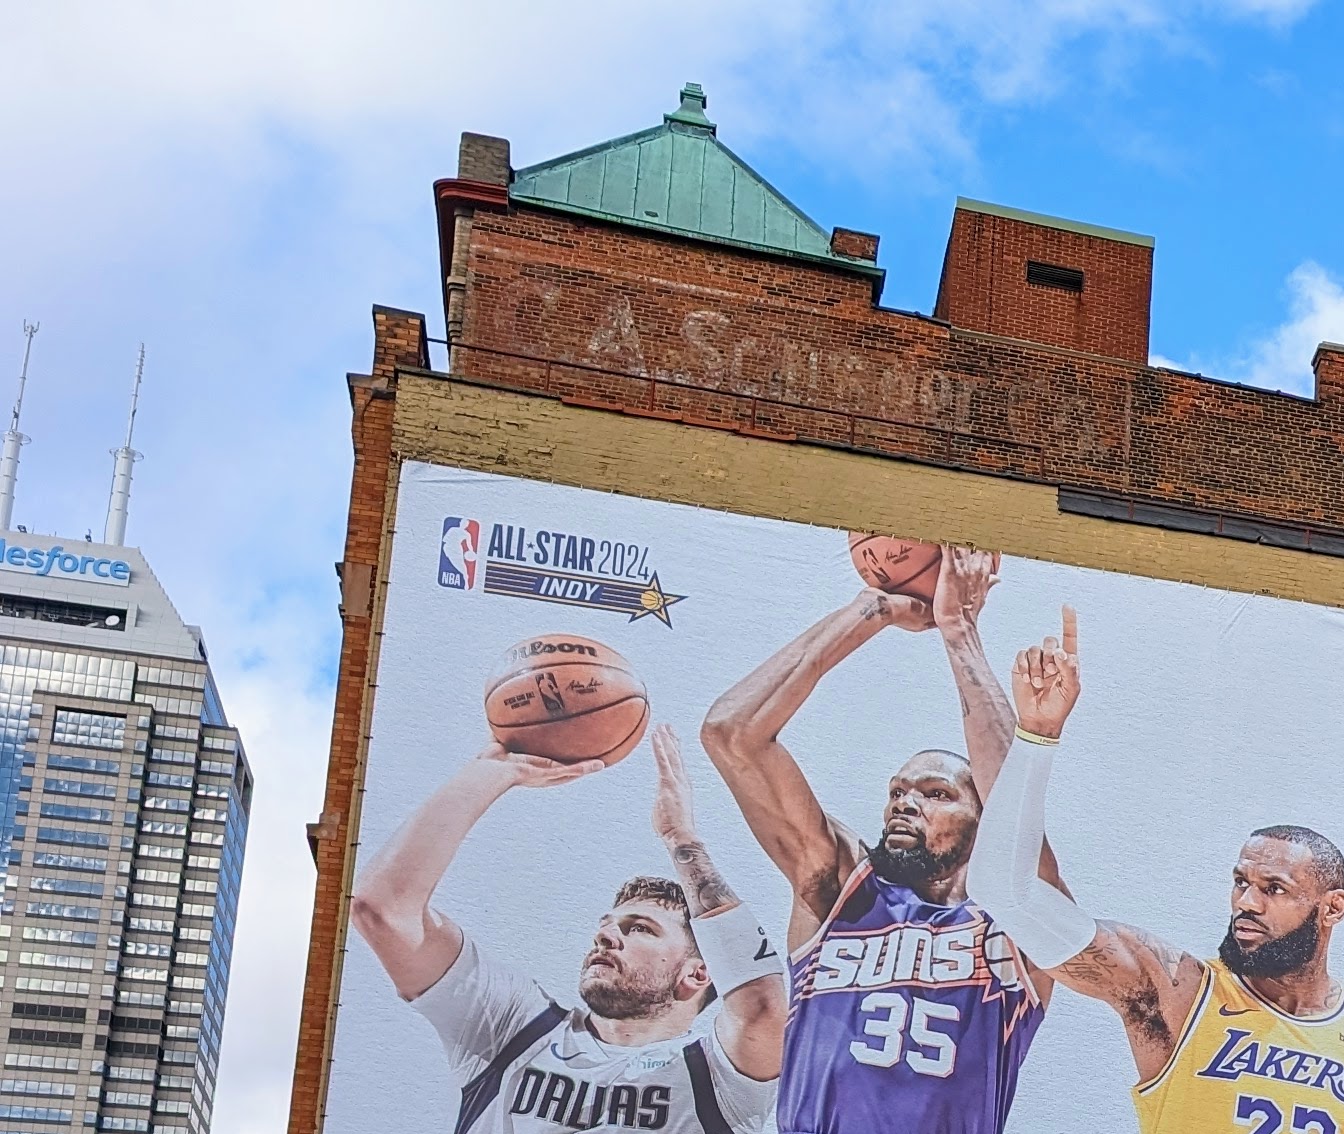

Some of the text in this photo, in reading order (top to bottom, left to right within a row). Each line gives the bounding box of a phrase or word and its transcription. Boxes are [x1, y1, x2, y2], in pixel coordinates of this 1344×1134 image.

[441, 571, 461, 586] NBA
[534, 530, 596, 572] STAR
[598, 540, 650, 580] 2024
[539, 577, 600, 601] INDY
[812, 927, 976, 990] SUNS
[850, 992, 960, 1078] 35
